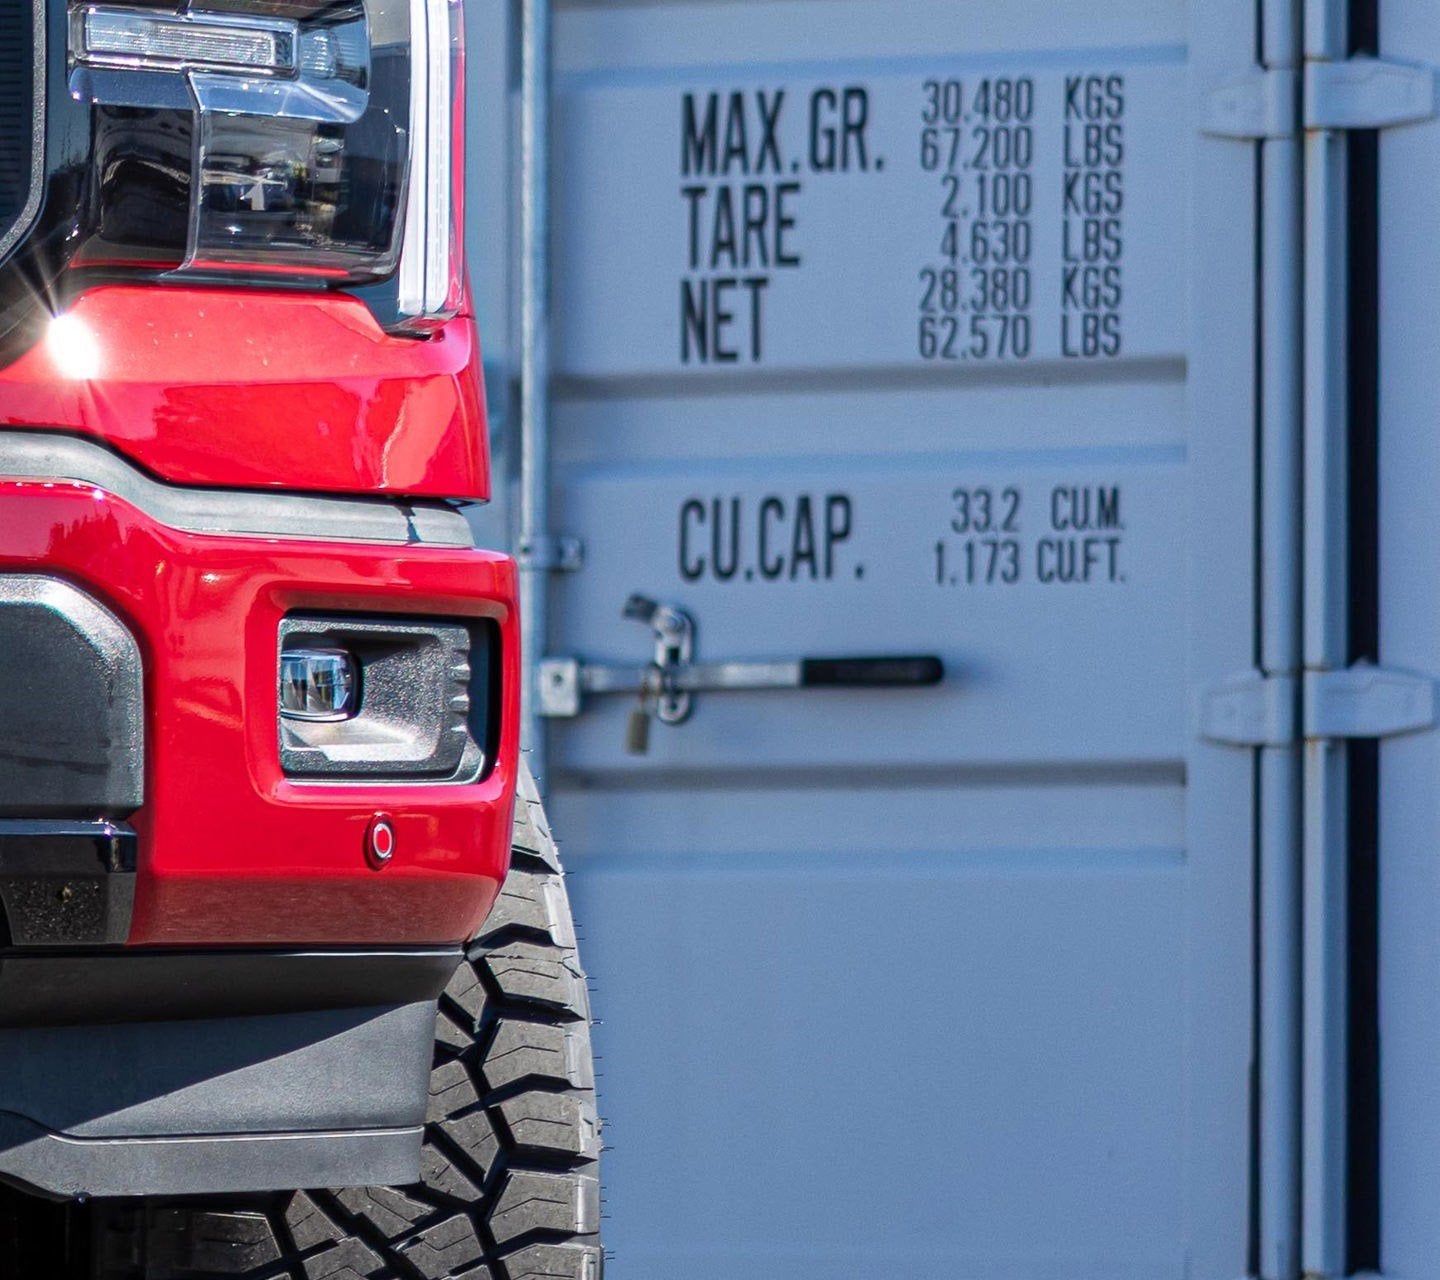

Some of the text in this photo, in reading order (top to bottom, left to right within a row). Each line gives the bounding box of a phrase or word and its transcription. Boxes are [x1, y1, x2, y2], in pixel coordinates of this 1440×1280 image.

[682, 75, 1125, 177] MAX.GR. 30.480 KGS
[920, 122, 1124, 170] 67.200 LBS
[682, 171, 1124, 268] TARE 2.100 KGS
[940, 219, 1122, 265] 4.630 LBS
[681, 266, 1122, 363] NET 28.380 KGS
[918, 313, 1121, 359] 62.570 LBS
[678, 494, 865, 582] CU.CAP.
[951, 489, 1021, 533] 33.2
[934, 539, 1021, 585] 1.173
